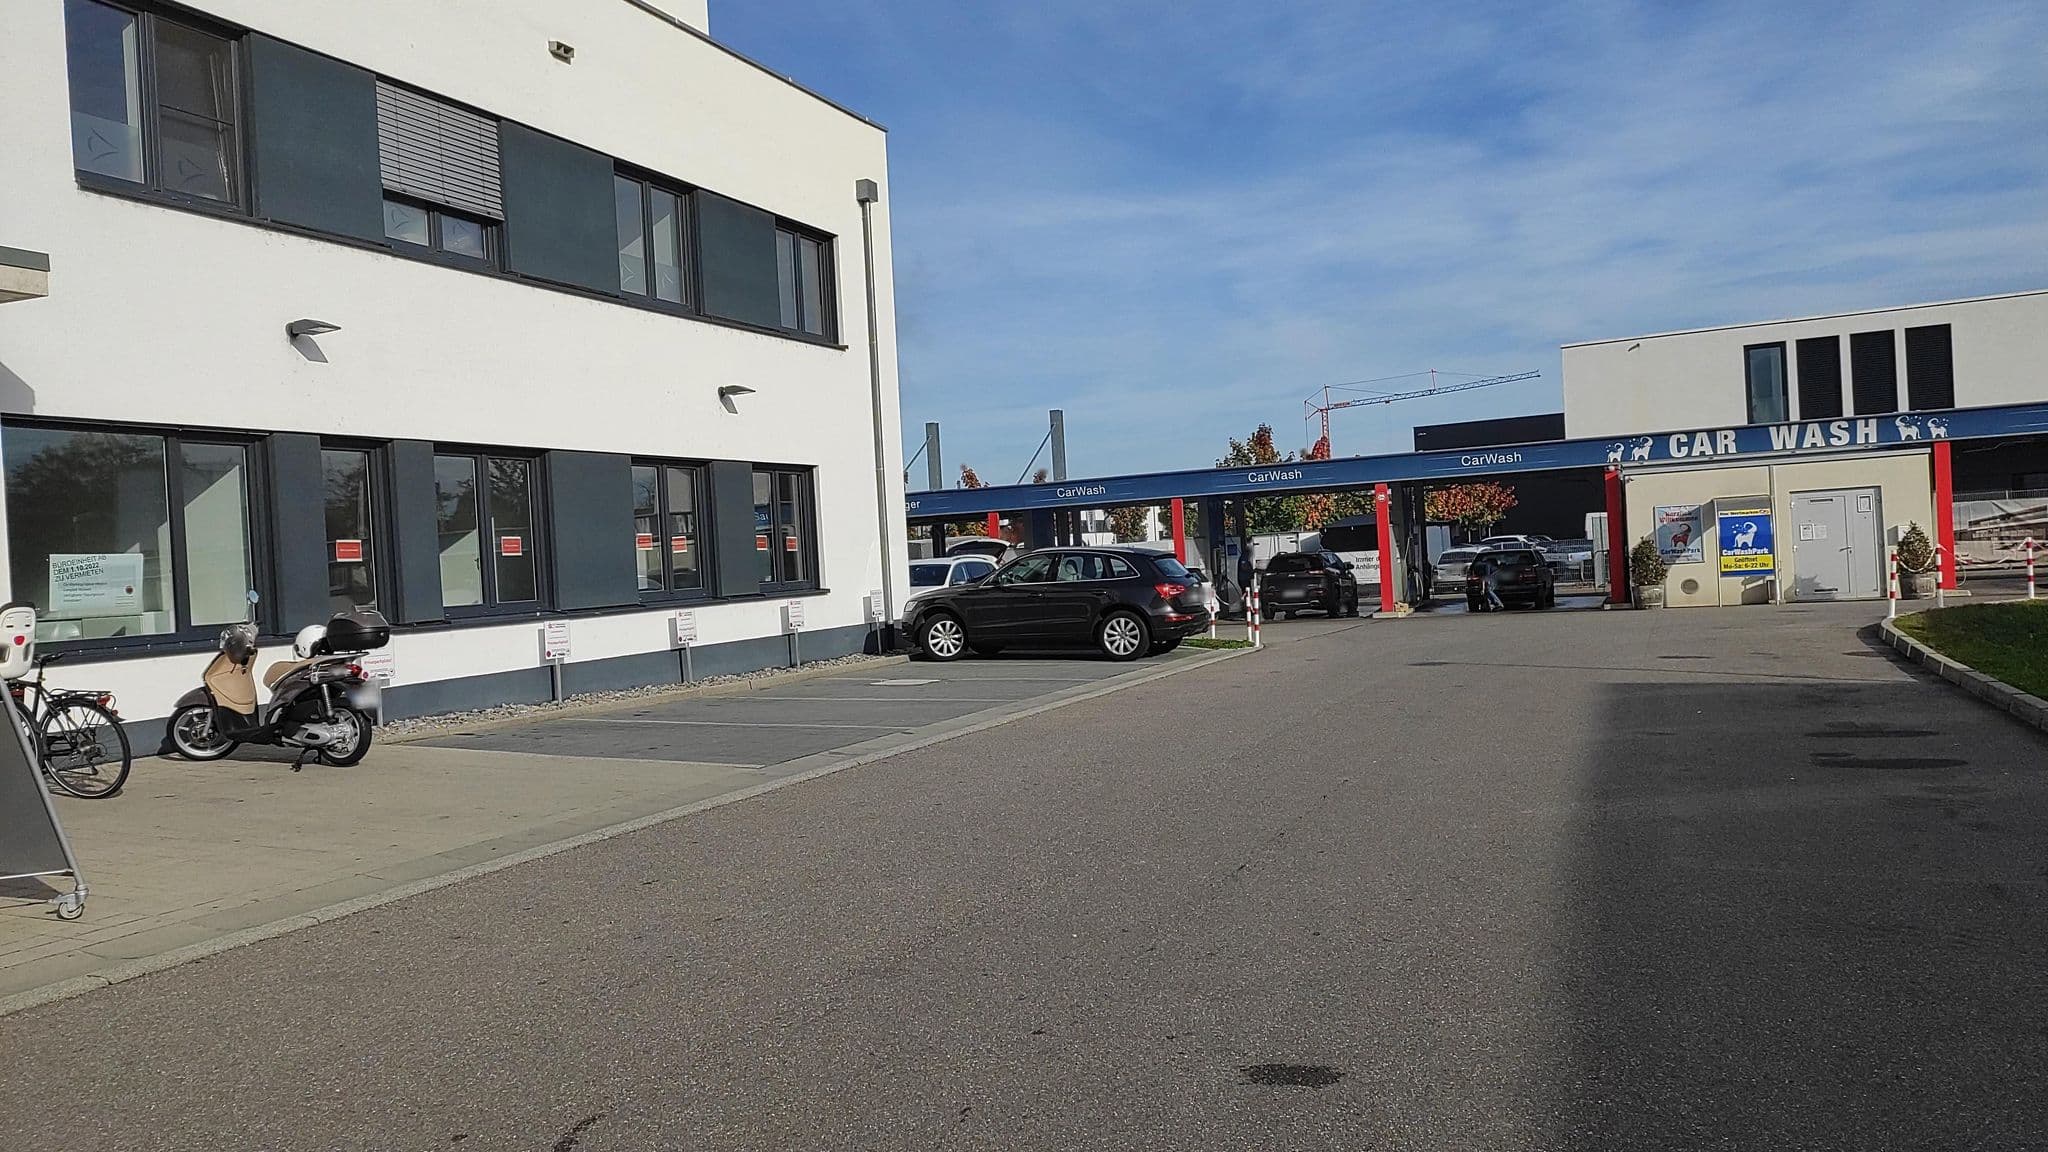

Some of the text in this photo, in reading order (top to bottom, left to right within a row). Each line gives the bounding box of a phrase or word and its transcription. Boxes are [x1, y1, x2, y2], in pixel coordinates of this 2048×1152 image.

[1669, 418, 1878, 458] CAR WASH
[1460, 452, 1522, 467] CarWash
[1248, 468, 1302, 483] CarWash
[1056, 484, 1106, 498] CarWash
[1722, 547, 1769, 556] CarWashPark
[53, 562, 99, 576] DEM 1.10.2022
[65, 567, 104, 580] VERMIETEN
